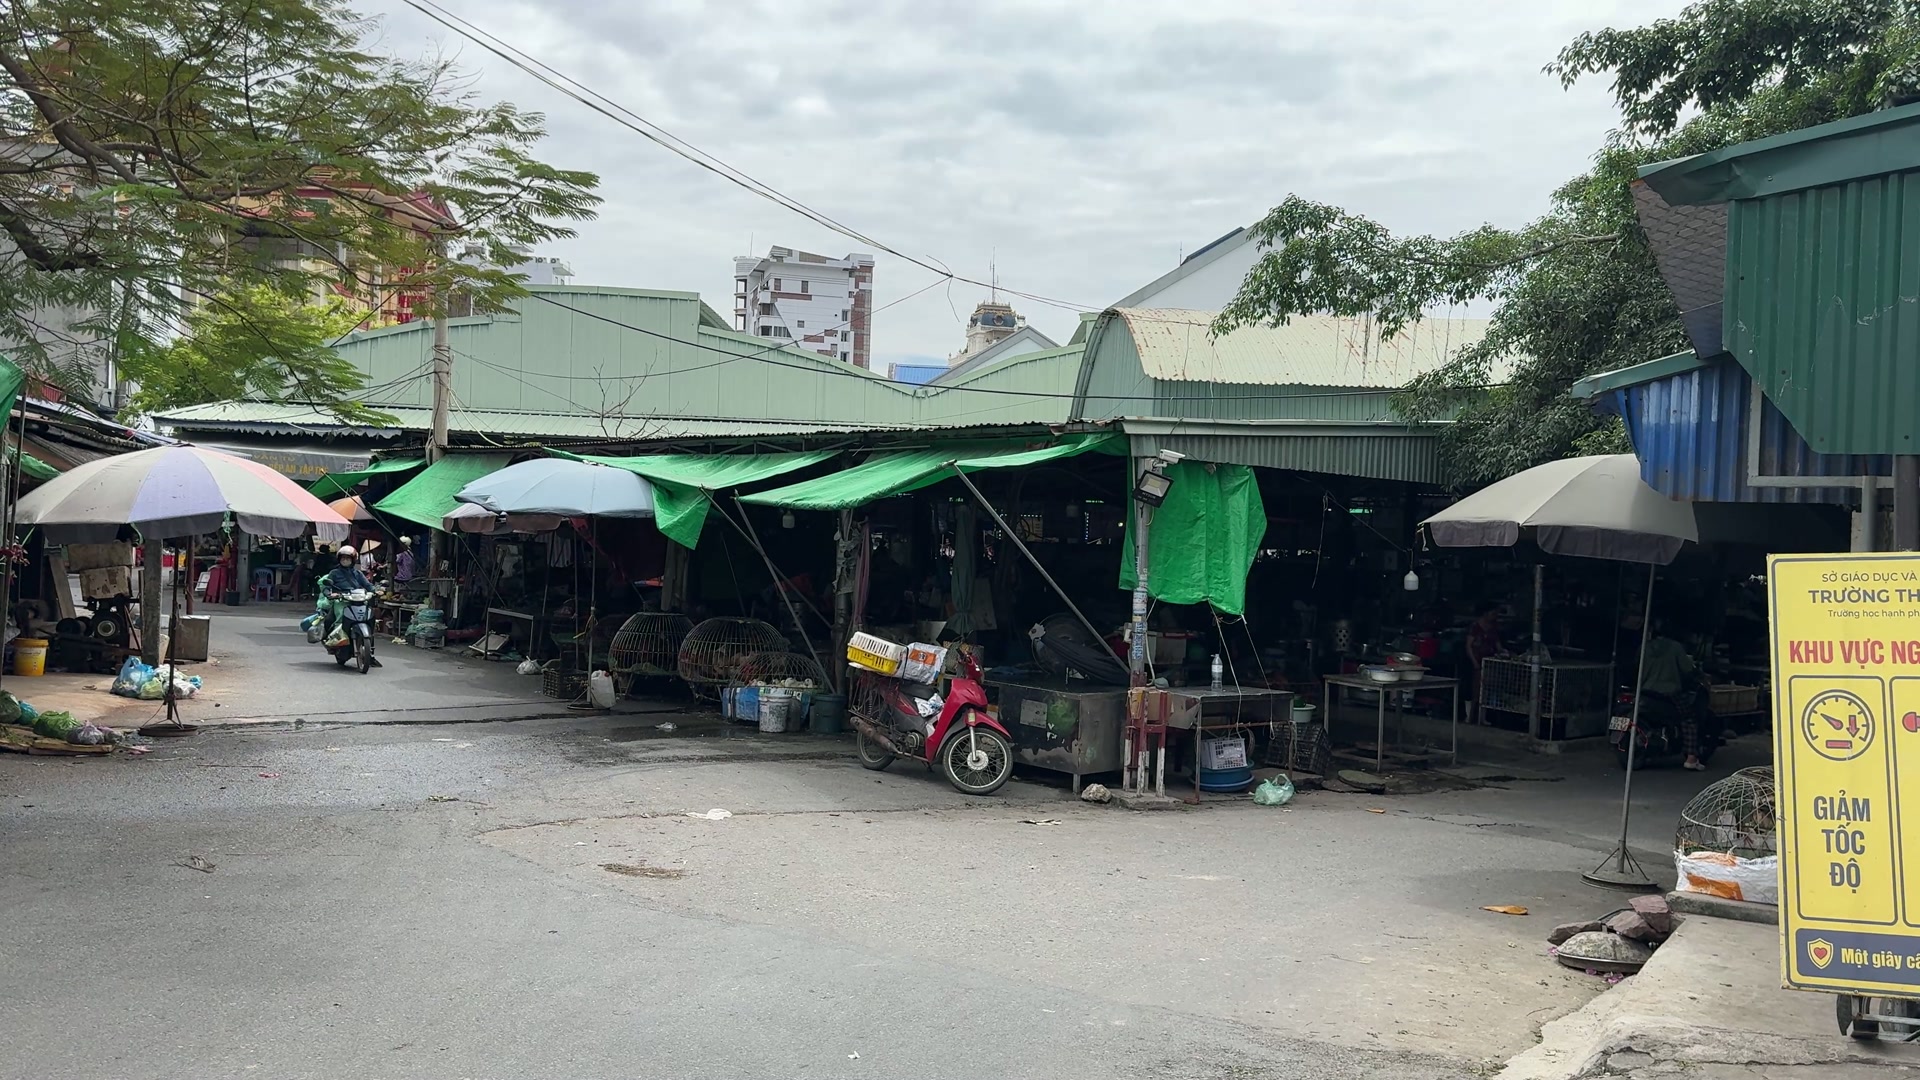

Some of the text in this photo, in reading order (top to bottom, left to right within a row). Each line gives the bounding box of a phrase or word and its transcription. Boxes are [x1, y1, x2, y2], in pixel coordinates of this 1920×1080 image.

[1822, 570, 1917, 583] SỞ GIÁO DỤC VÀ
[1808, 586, 1920, 603] TRƯỜNG TH
[1828, 609, 1860, 619] Trường
[1862, 609, 1879, 619] học
[1882, 609, 1905, 619] hạnh
[1789, 638, 1920, 669] KHU VỰC NG
[1813, 789, 1871, 822] GIẢM
[1821, 822, 1865, 855] TỐC
[1829, 858, 1861, 894] ĐỘ
[1841, 947, 1869, 968] Một
[1872, 950, 1903, 970] giây
